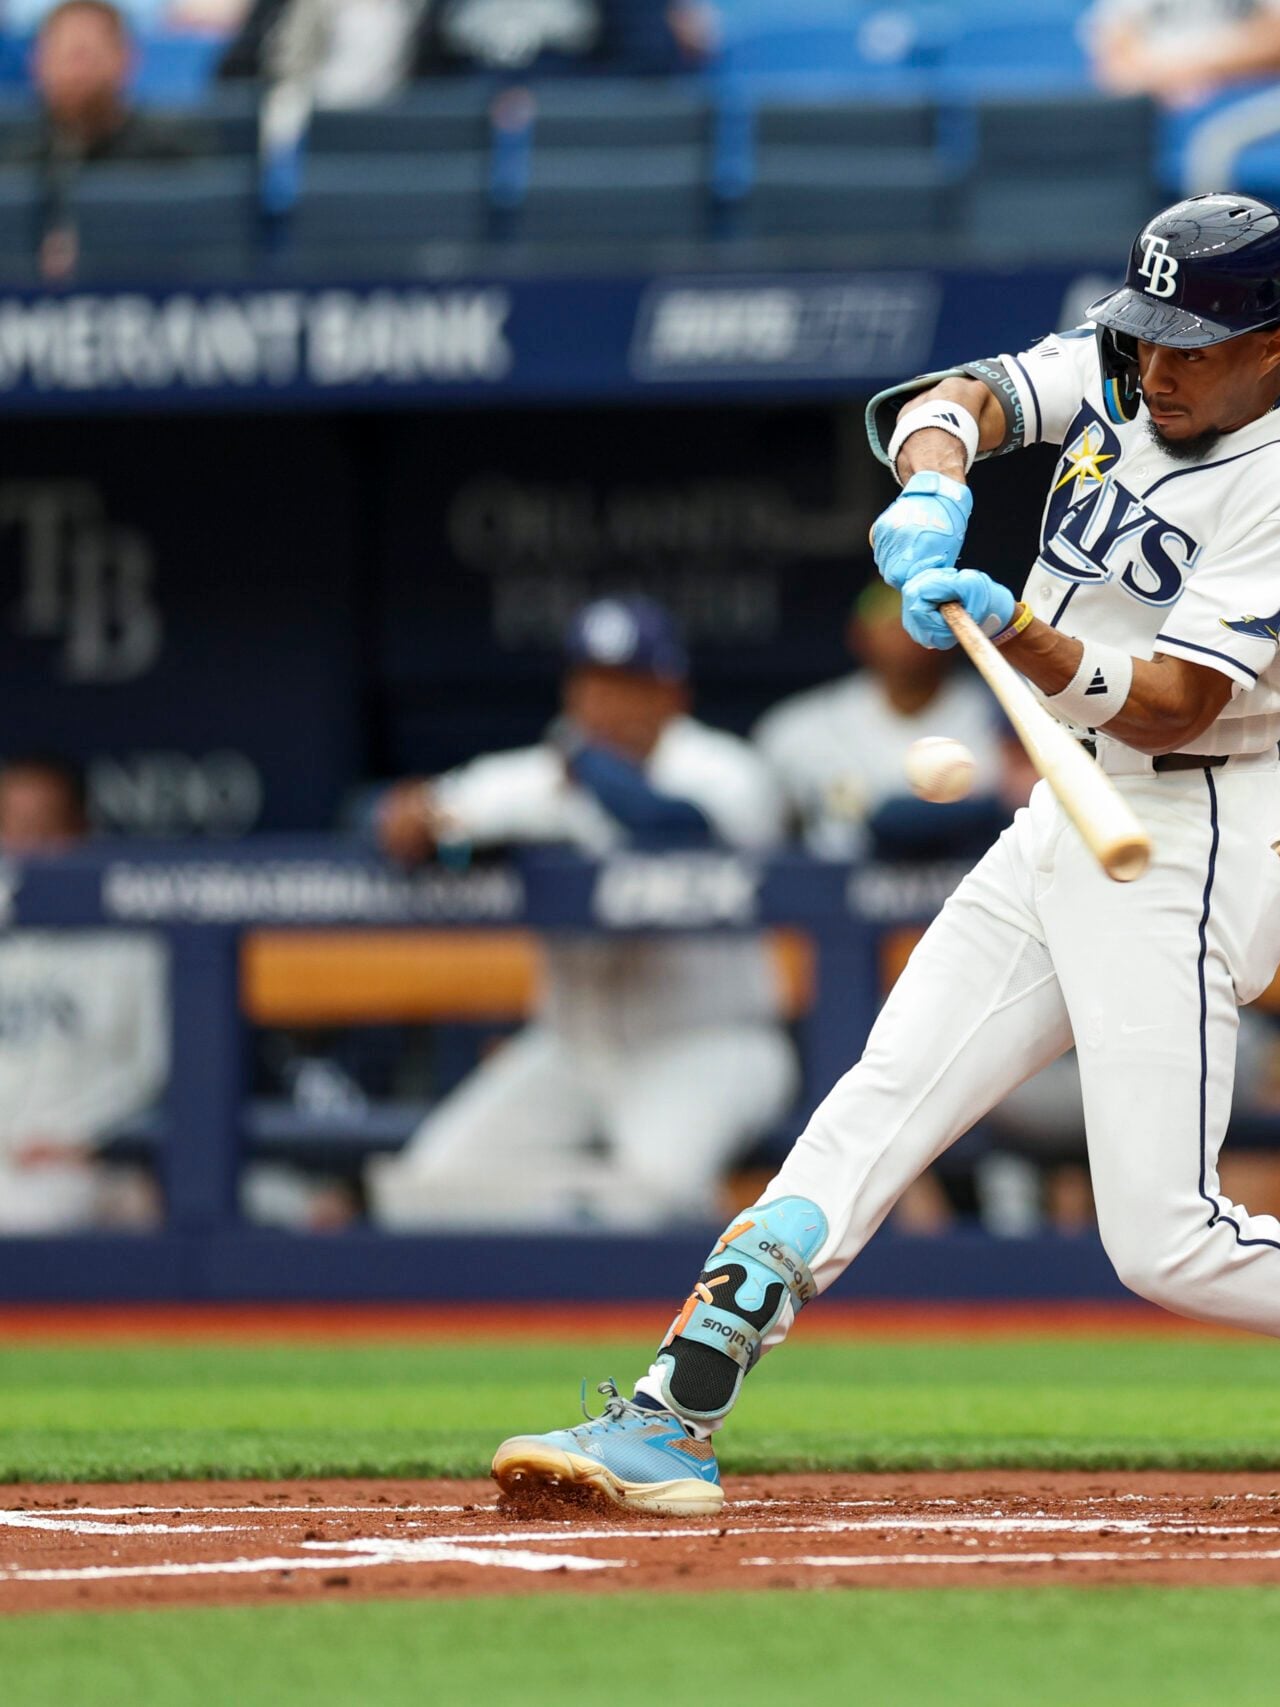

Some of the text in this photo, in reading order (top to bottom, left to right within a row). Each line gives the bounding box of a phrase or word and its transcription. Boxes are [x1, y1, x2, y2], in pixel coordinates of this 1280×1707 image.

[1138, 233, 1179, 298] TB
[0, 291, 300, 390] MERANT
[758, 1240, 811, 1308] absolu
[701, 1317, 754, 1366] culous
